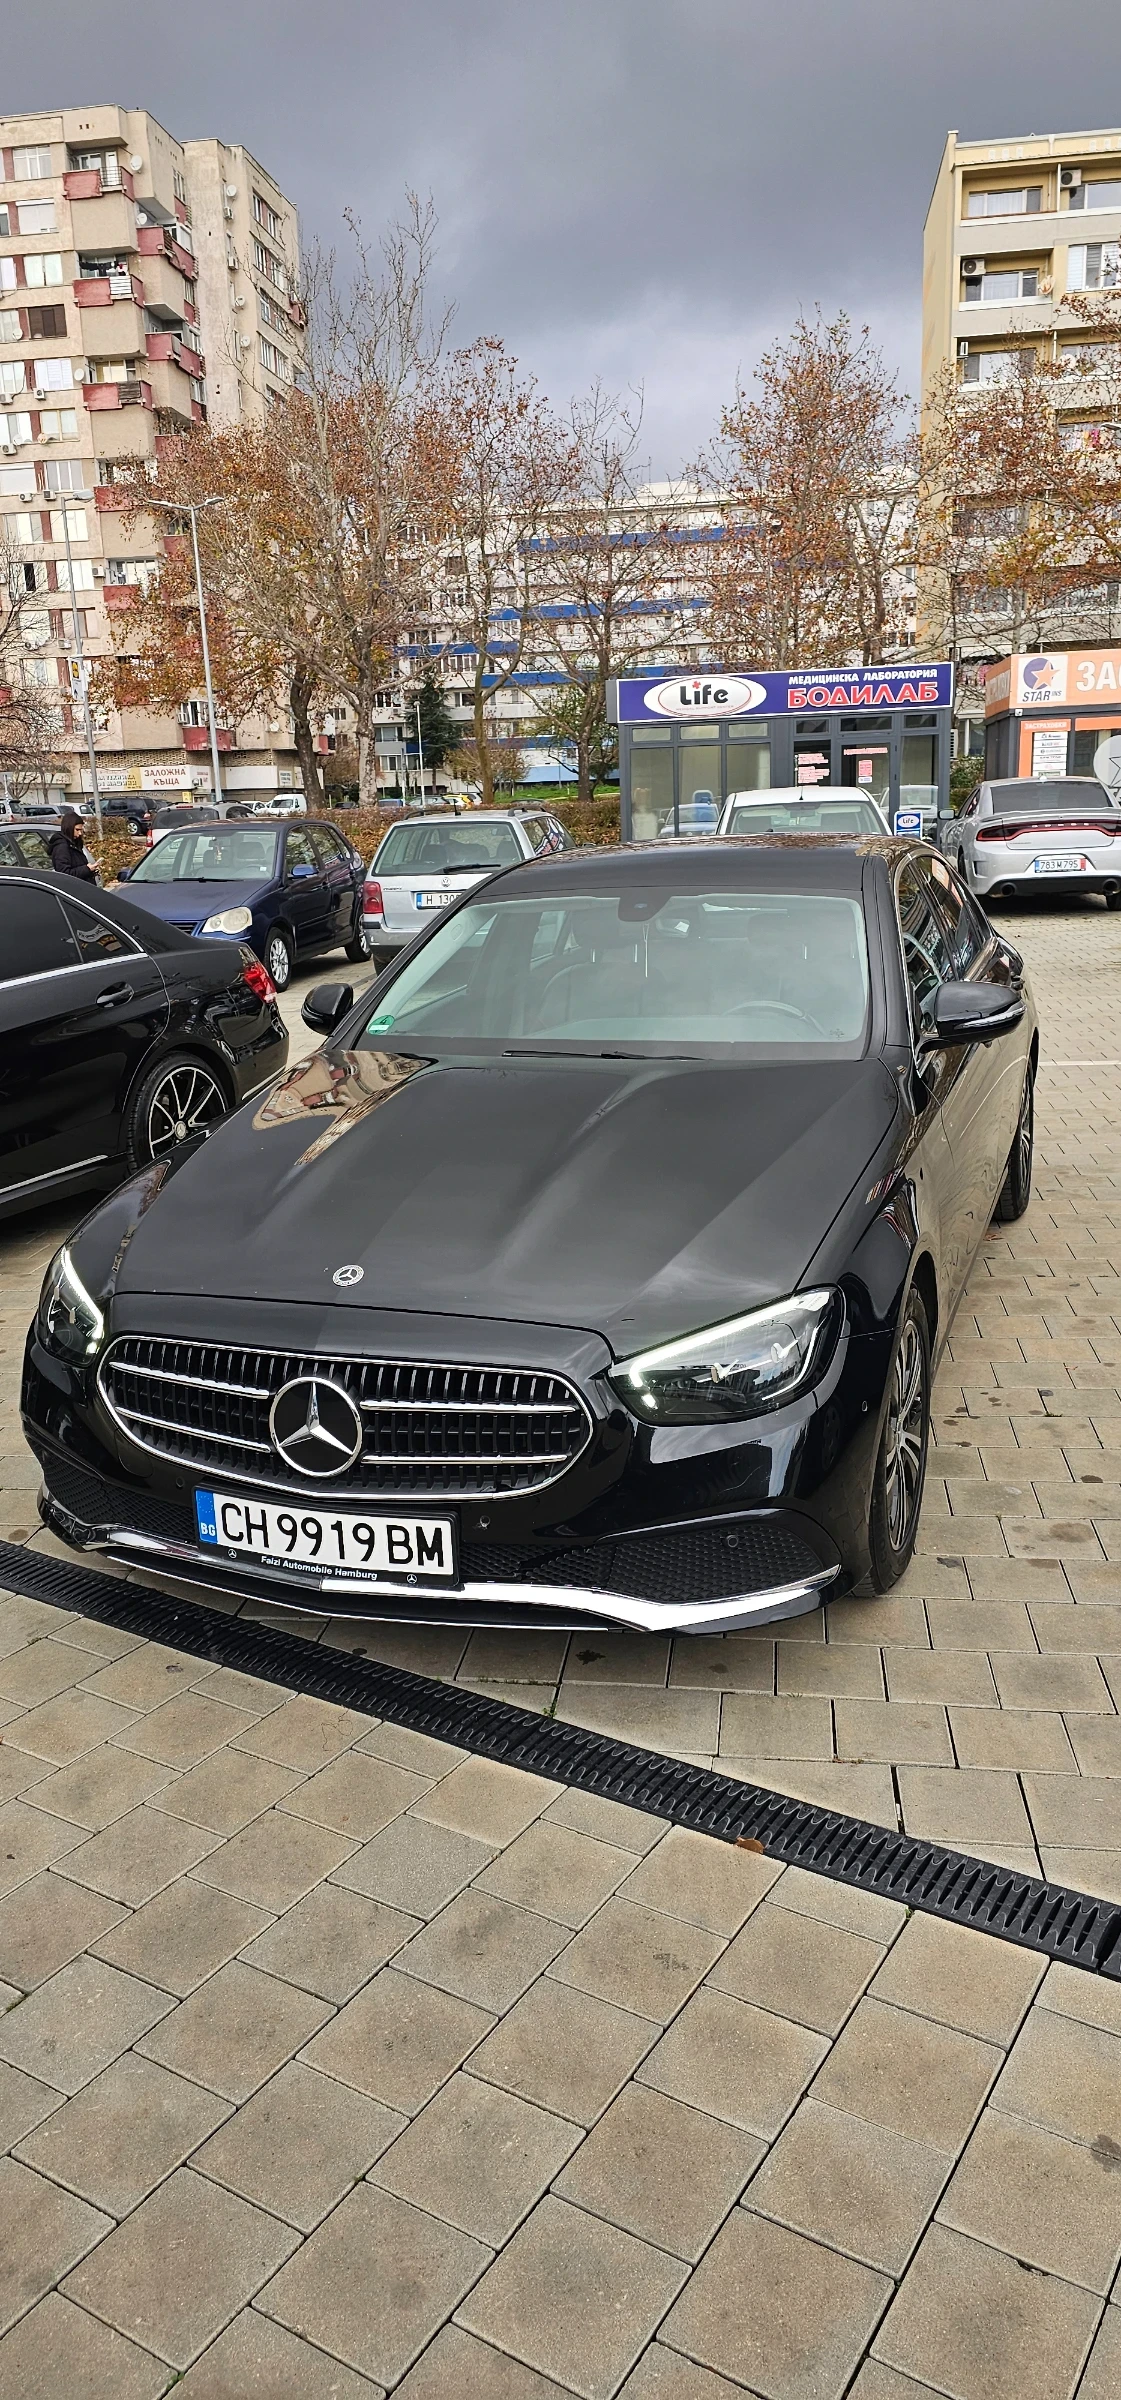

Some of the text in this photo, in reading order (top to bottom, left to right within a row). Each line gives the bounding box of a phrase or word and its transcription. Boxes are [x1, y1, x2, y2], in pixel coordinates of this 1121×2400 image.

[789, 669, 937, 685] МЕДИЦИНСКА ЛАБОРАТОРИЯ
[1076, 660, 1121, 692] ЗА
[679, 680, 729, 705] Life
[787, 681, 939, 709] БОДИЛАБ
[1022, 690, 1051, 702] STAR
[144, 768, 186, 777] ЗАЛОЖНА
[153, 778, 180, 786] КЪЩА
[426, 894, 433, 905] H
[200, 1522, 216, 1537] BG
[282, 1560, 333, 1575] Automobile
[334, 1568, 378, 1581] Hamburg
